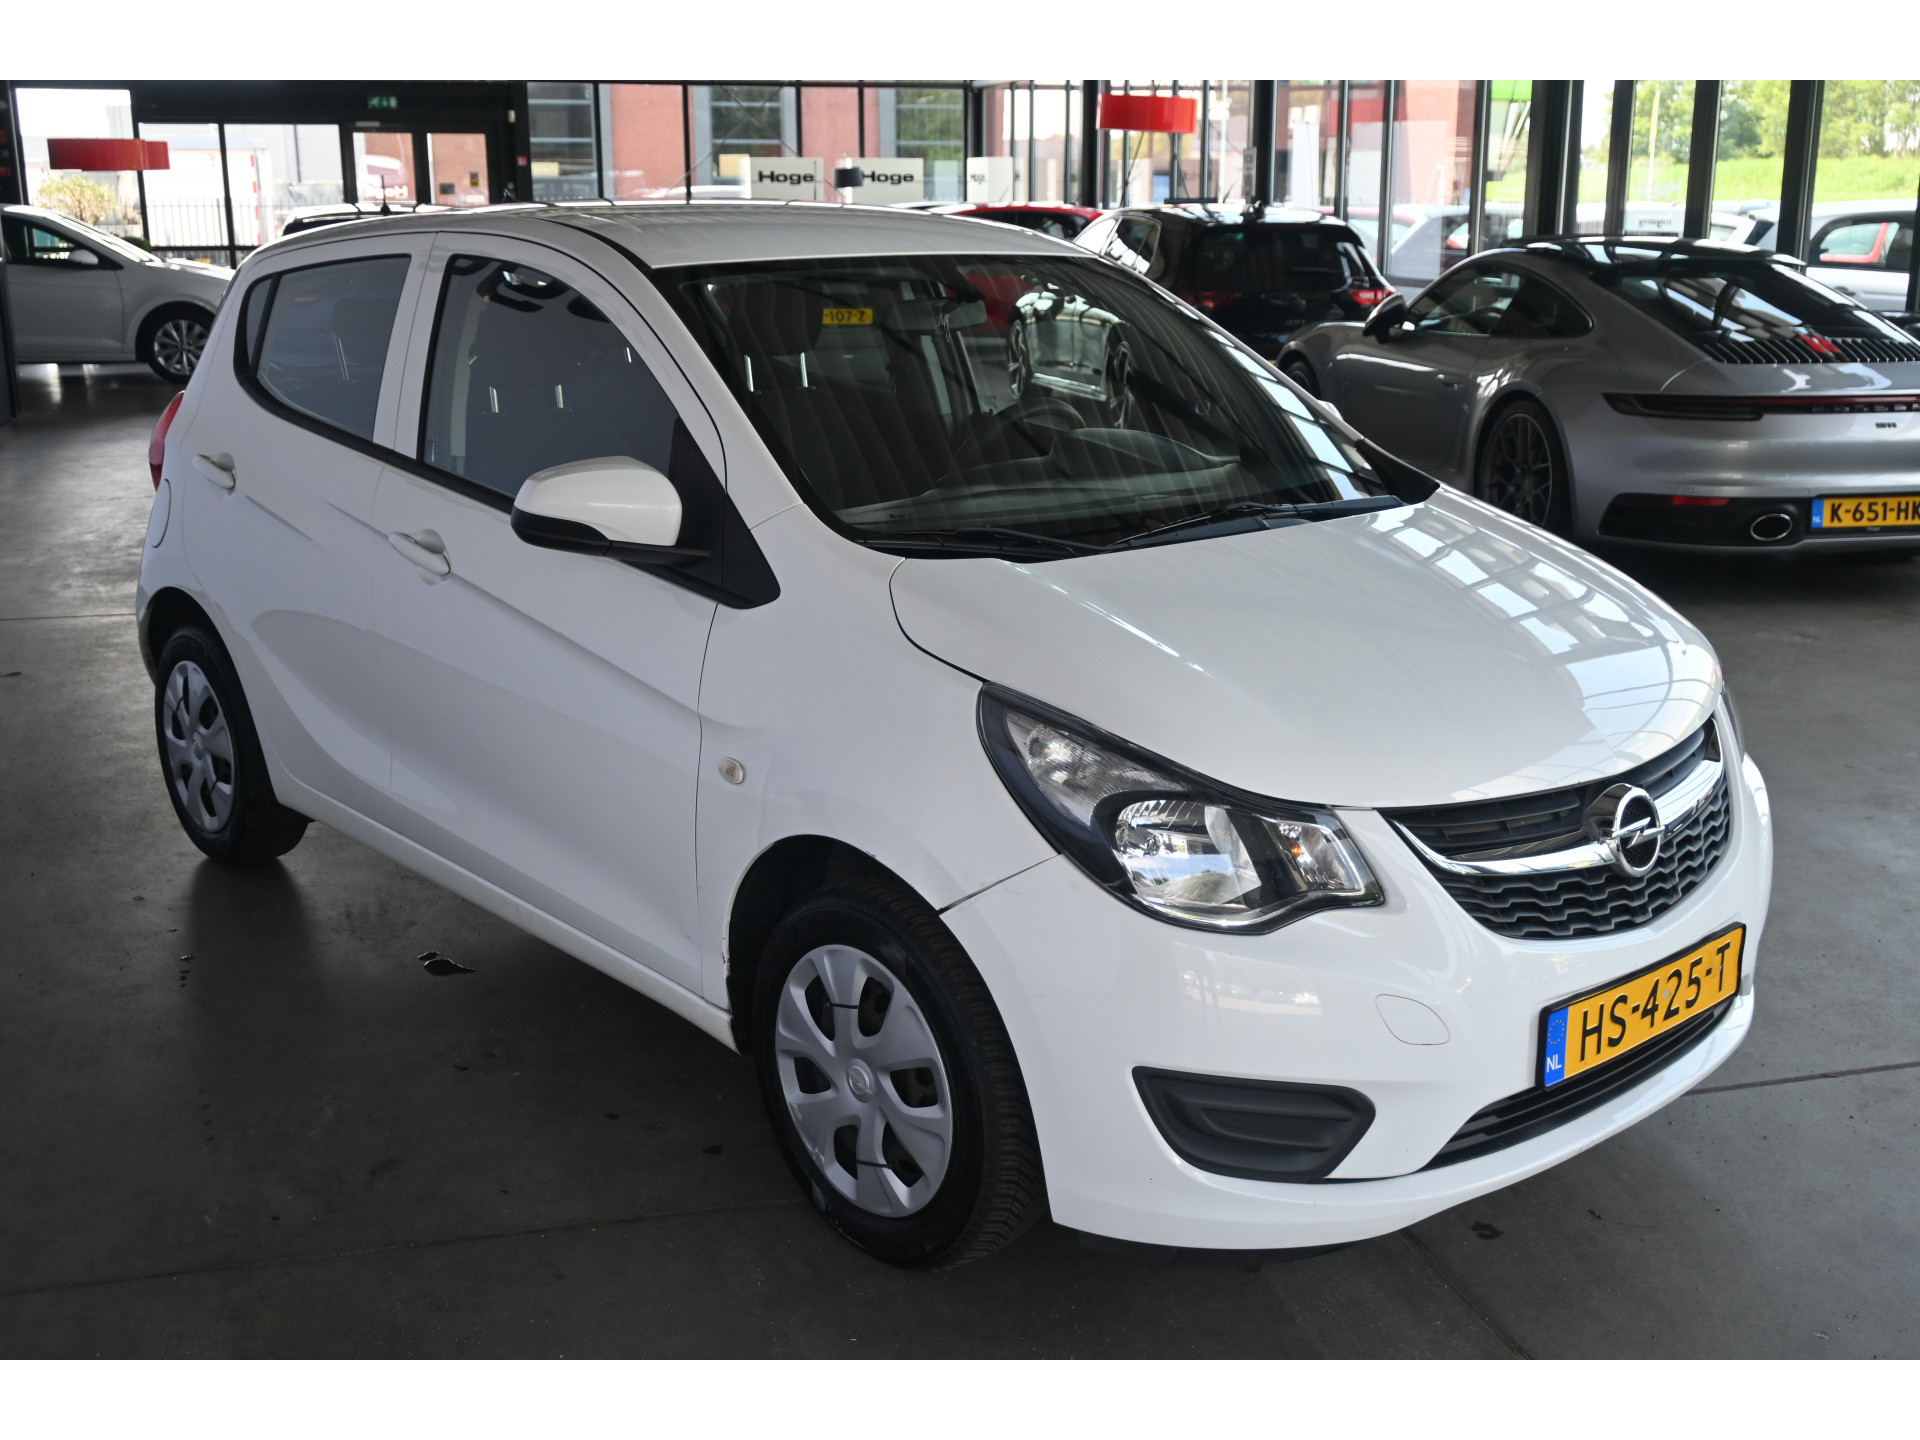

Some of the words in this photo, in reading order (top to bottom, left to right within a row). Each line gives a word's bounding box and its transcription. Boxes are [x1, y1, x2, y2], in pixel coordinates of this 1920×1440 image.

[758, 170, 815, 185] Hoge
[862, 170, 915, 185] Hoge
[1830, 501, 1920, 523] K-651-HK
[1580, 942, 1731, 1062] HS-425-T
[1546, 1054, 1562, 1073] NL
